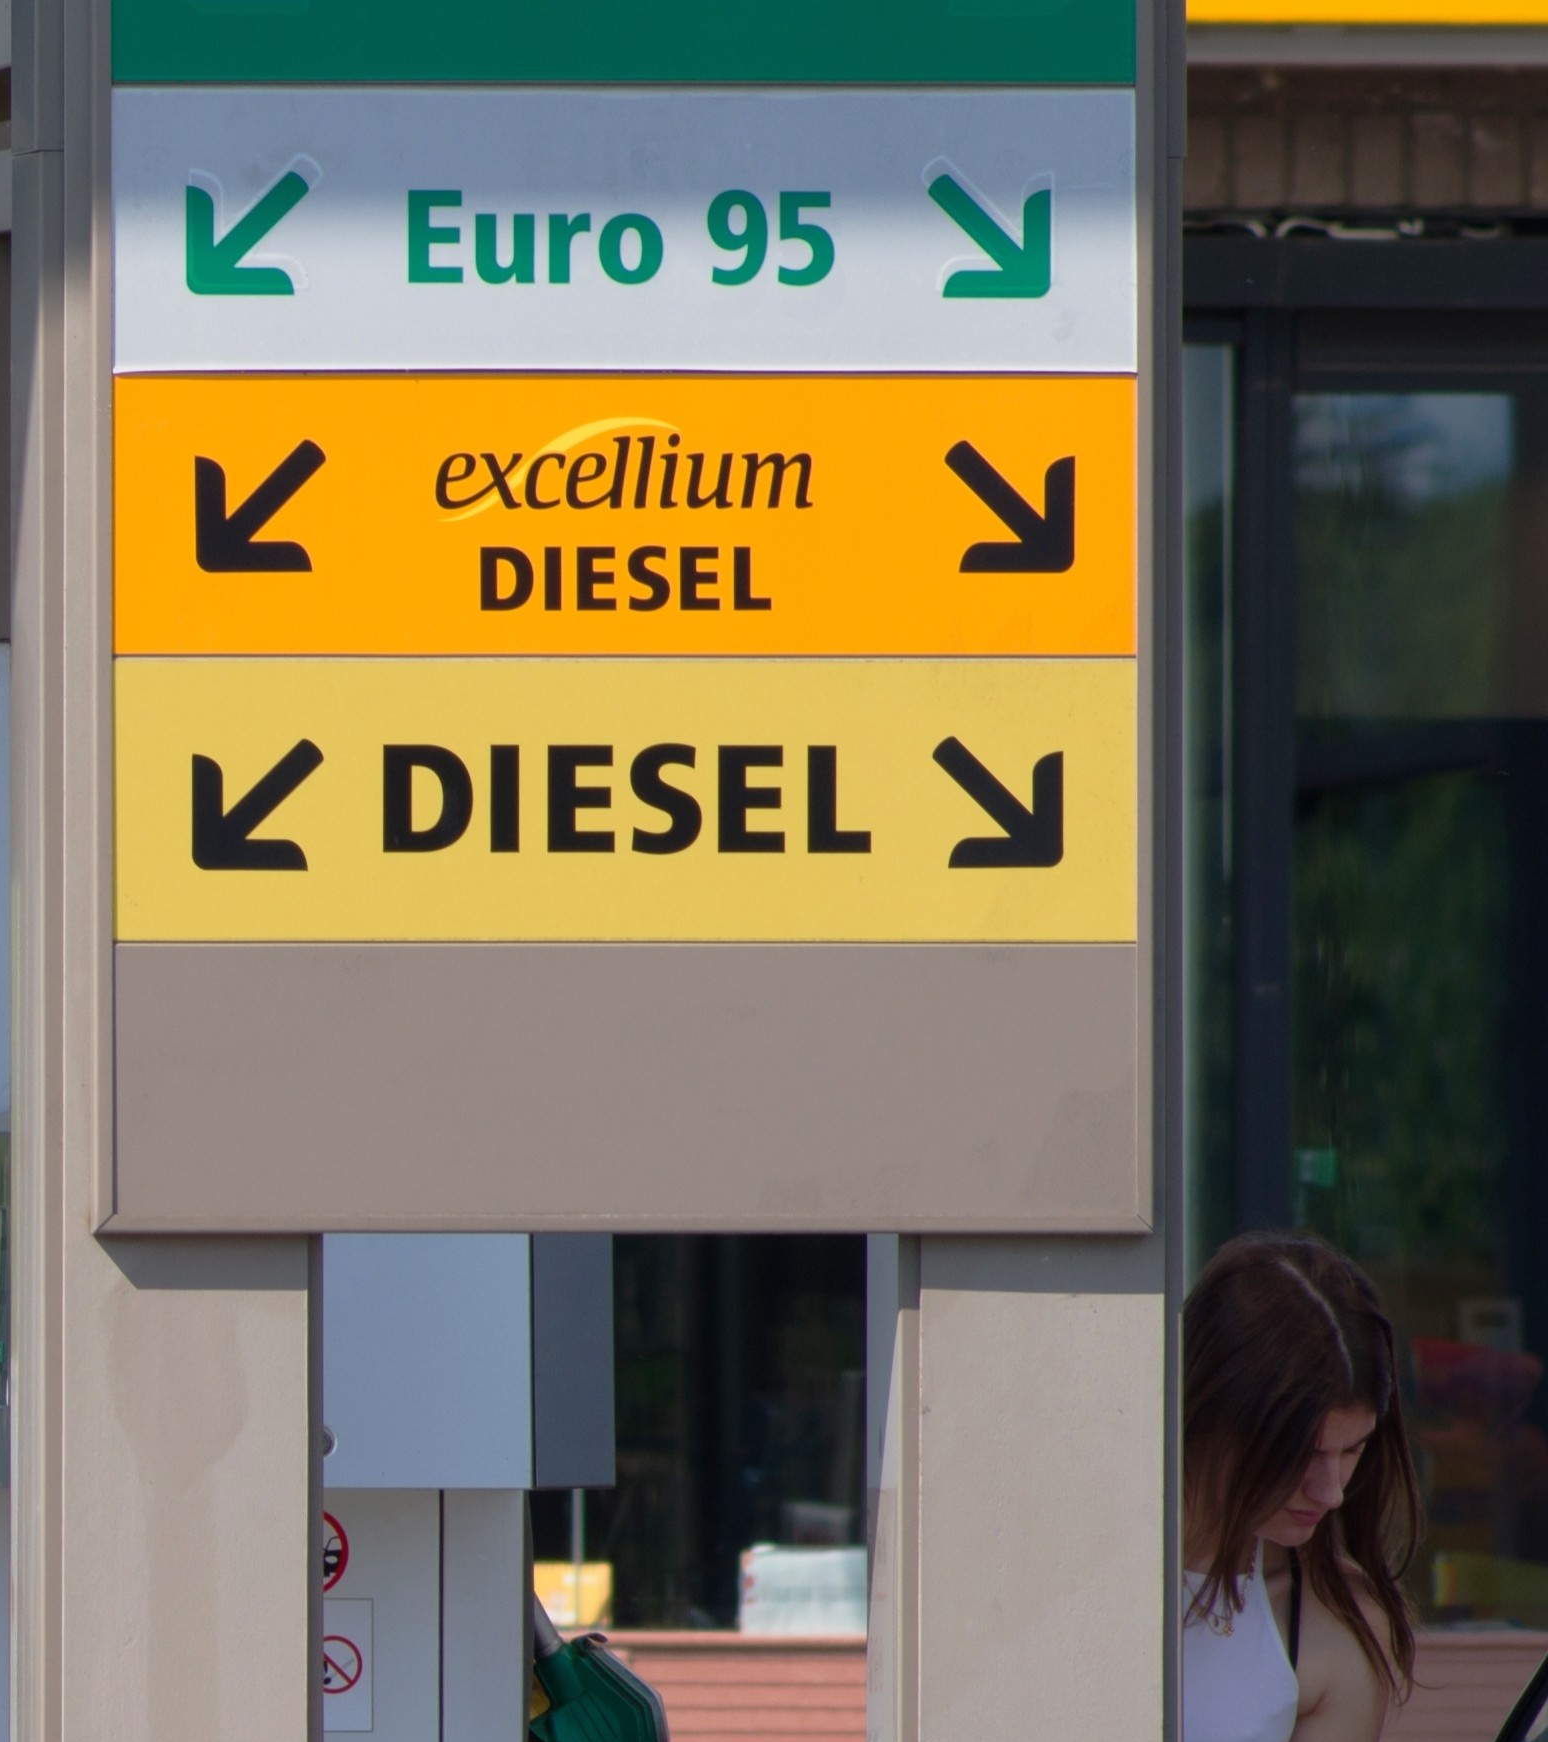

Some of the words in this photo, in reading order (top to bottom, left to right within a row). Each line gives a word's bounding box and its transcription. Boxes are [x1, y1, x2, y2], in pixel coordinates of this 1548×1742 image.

[406, 189, 663, 286] Euro
[707, 189, 835, 287] 95
[436, 434, 813, 511] excellium
[481, 546, 771, 611] DIESEL
[383, 744, 871, 854] DIESEL
